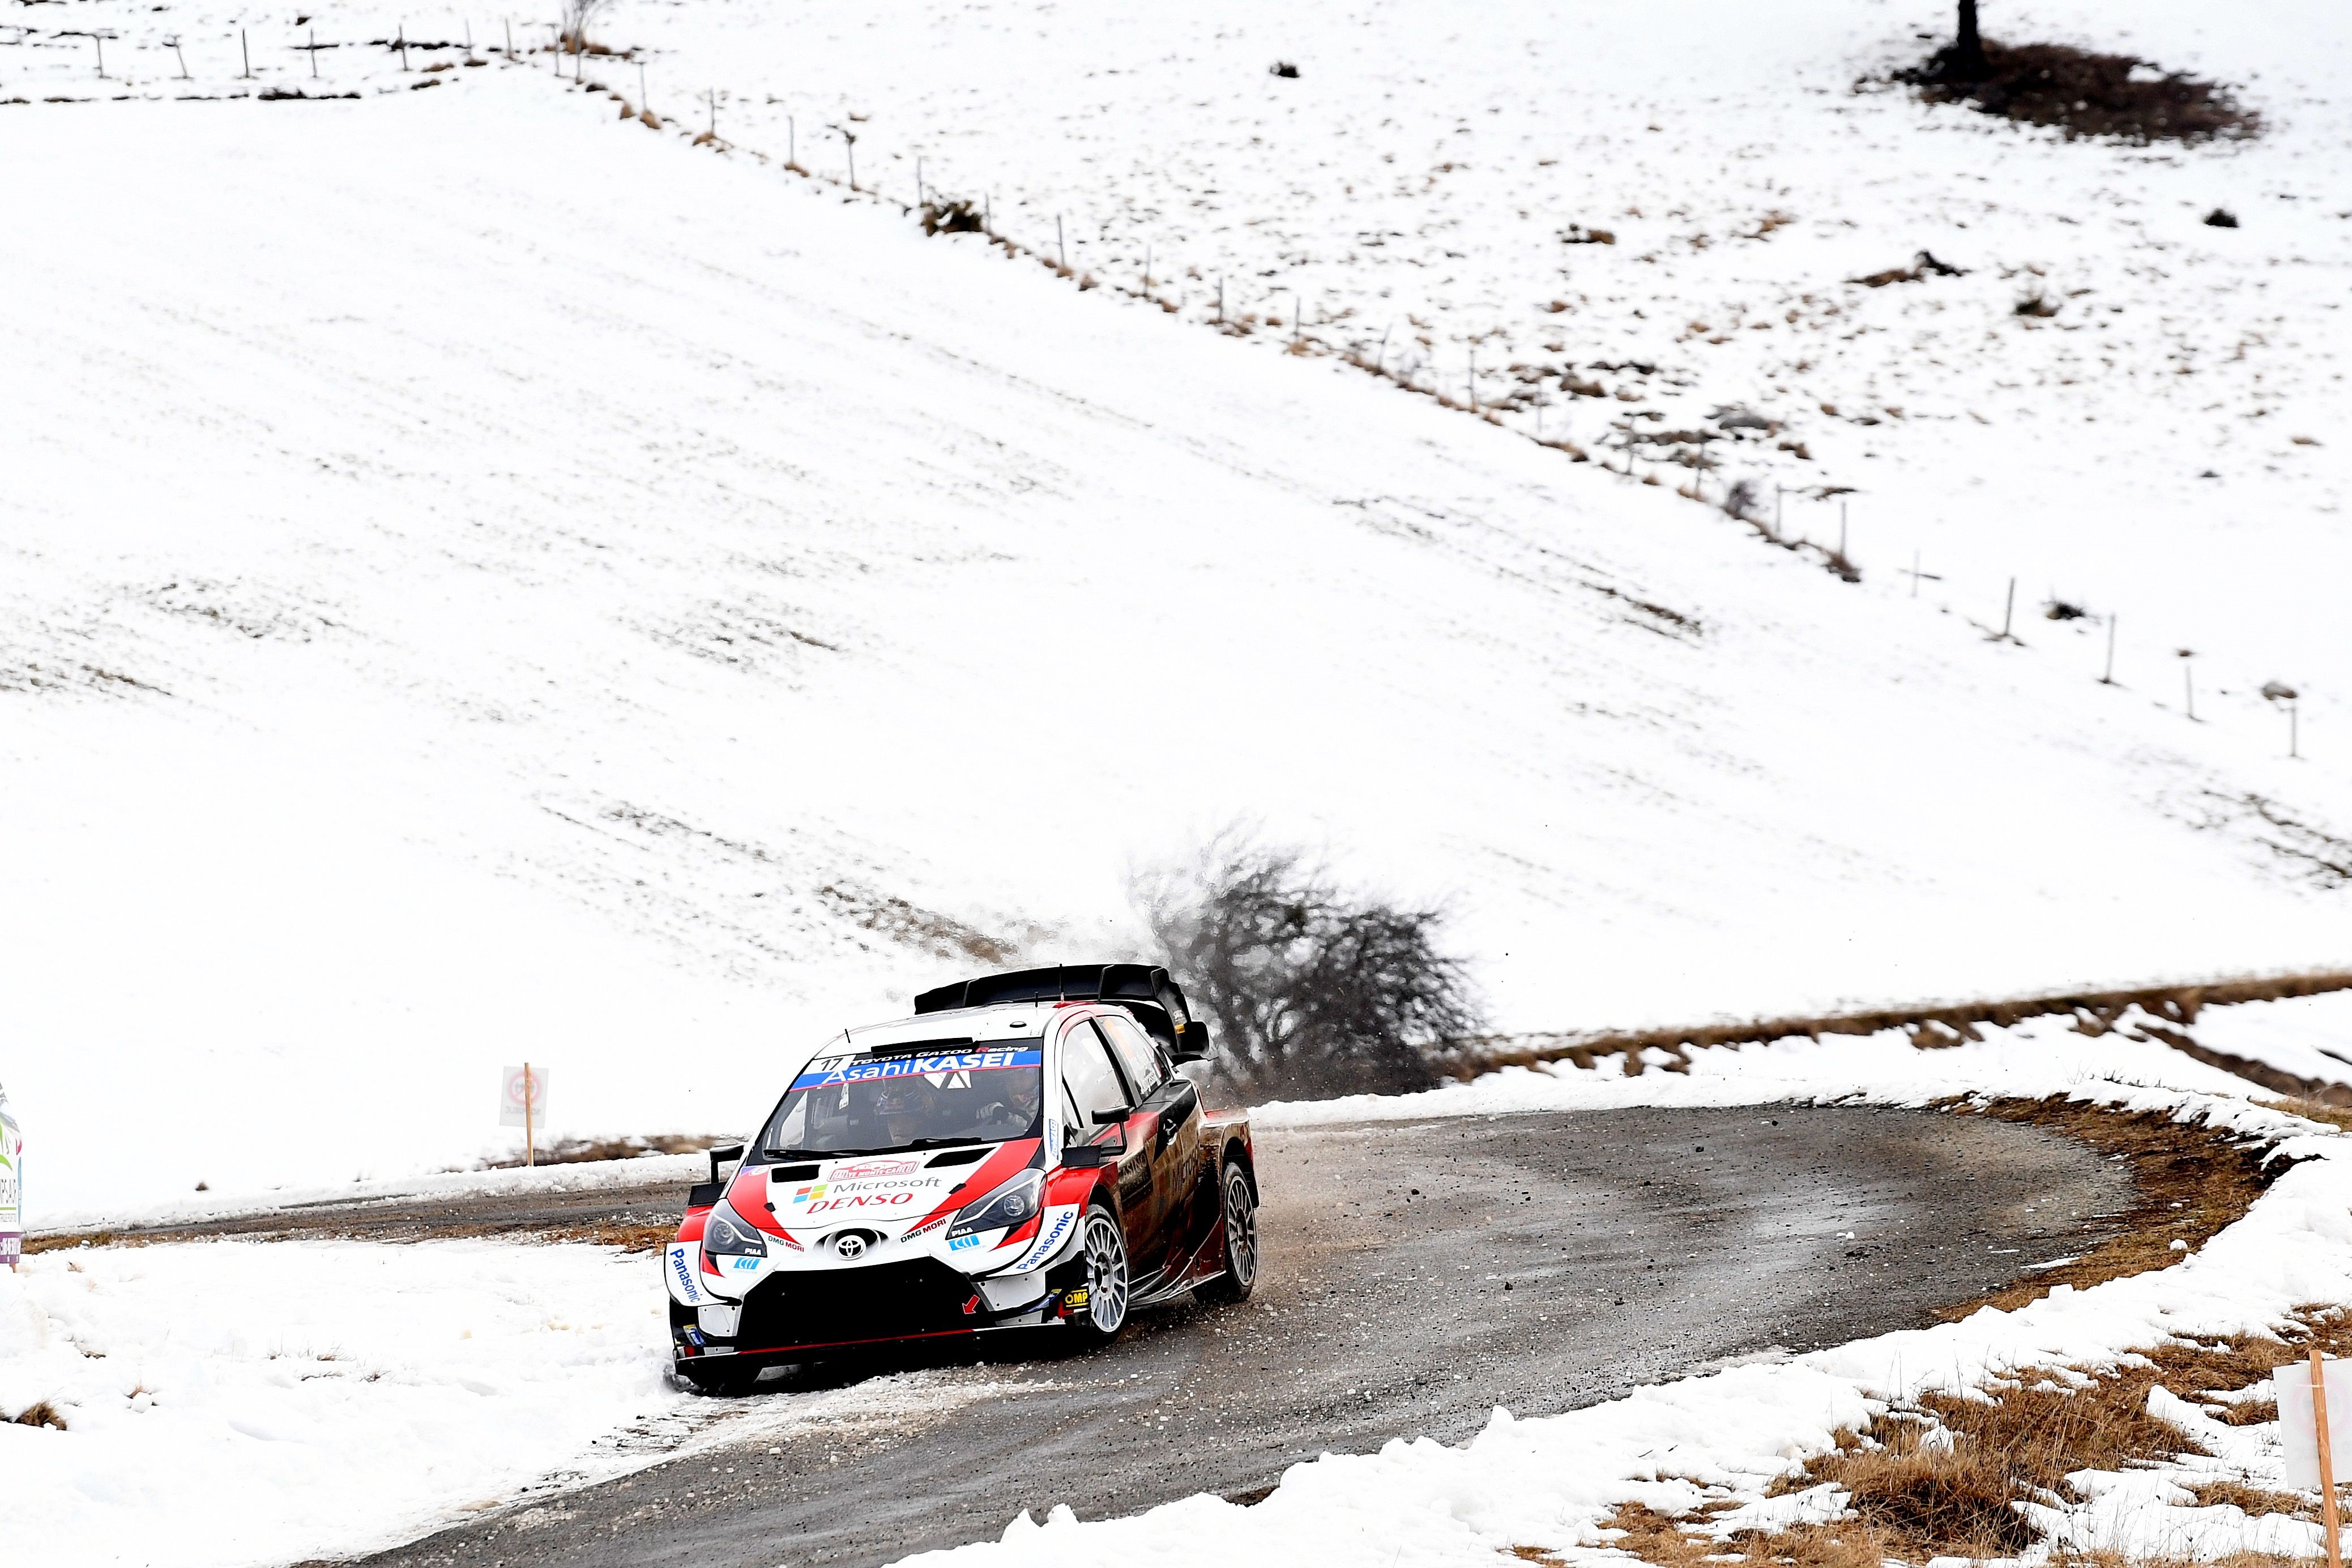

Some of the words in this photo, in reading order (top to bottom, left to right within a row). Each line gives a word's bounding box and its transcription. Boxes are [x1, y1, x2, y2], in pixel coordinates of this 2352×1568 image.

[820, 1059, 843, 1072] 17
[851, 1052, 912, 1065] TOYOTA
[915, 1049, 973, 1058] GAZOO
[832, 1171, 857, 1180] RALLYE
[833, 1177, 942, 1194] Microsoft
[806, 1193, 914, 1215] DENSO
[900, 1230, 922, 1244] DMG
[923, 1218, 946, 1233] MORI
[951, 1227, 974, 1237] PIAA
[768, 1235, 784, 1246] DMG
[785, 1241, 805, 1253] MORI
[1015, 1211, 1074, 1270] Panasonic
[670, 1247, 701, 1303] Panasonic
[1065, 1292, 1089, 1304] OMP
